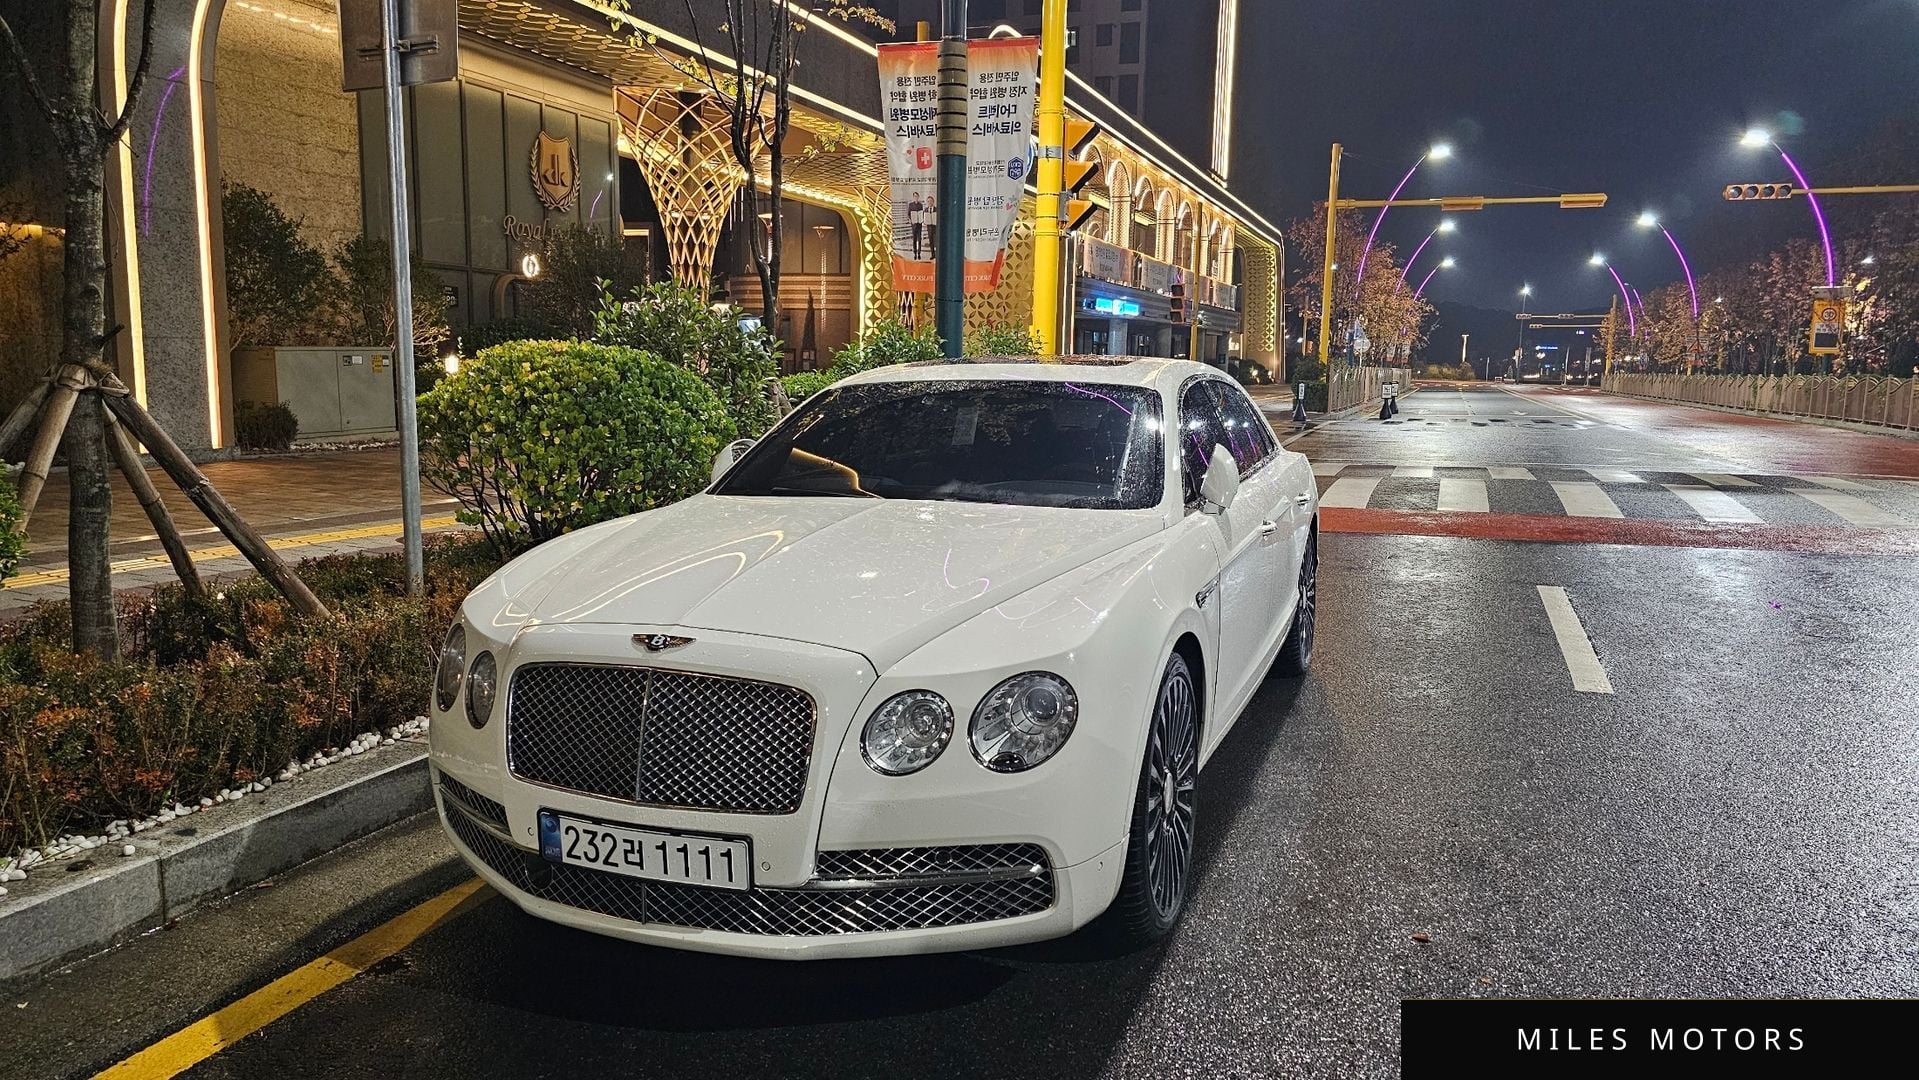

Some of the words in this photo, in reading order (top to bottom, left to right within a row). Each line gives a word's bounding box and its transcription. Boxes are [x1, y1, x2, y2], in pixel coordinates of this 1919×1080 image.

[504, 215, 550, 240] Royal
[650, 635, 666, 646] B
[564, 825, 645, 870] 232러
[655, 840, 735, 883] 1111
